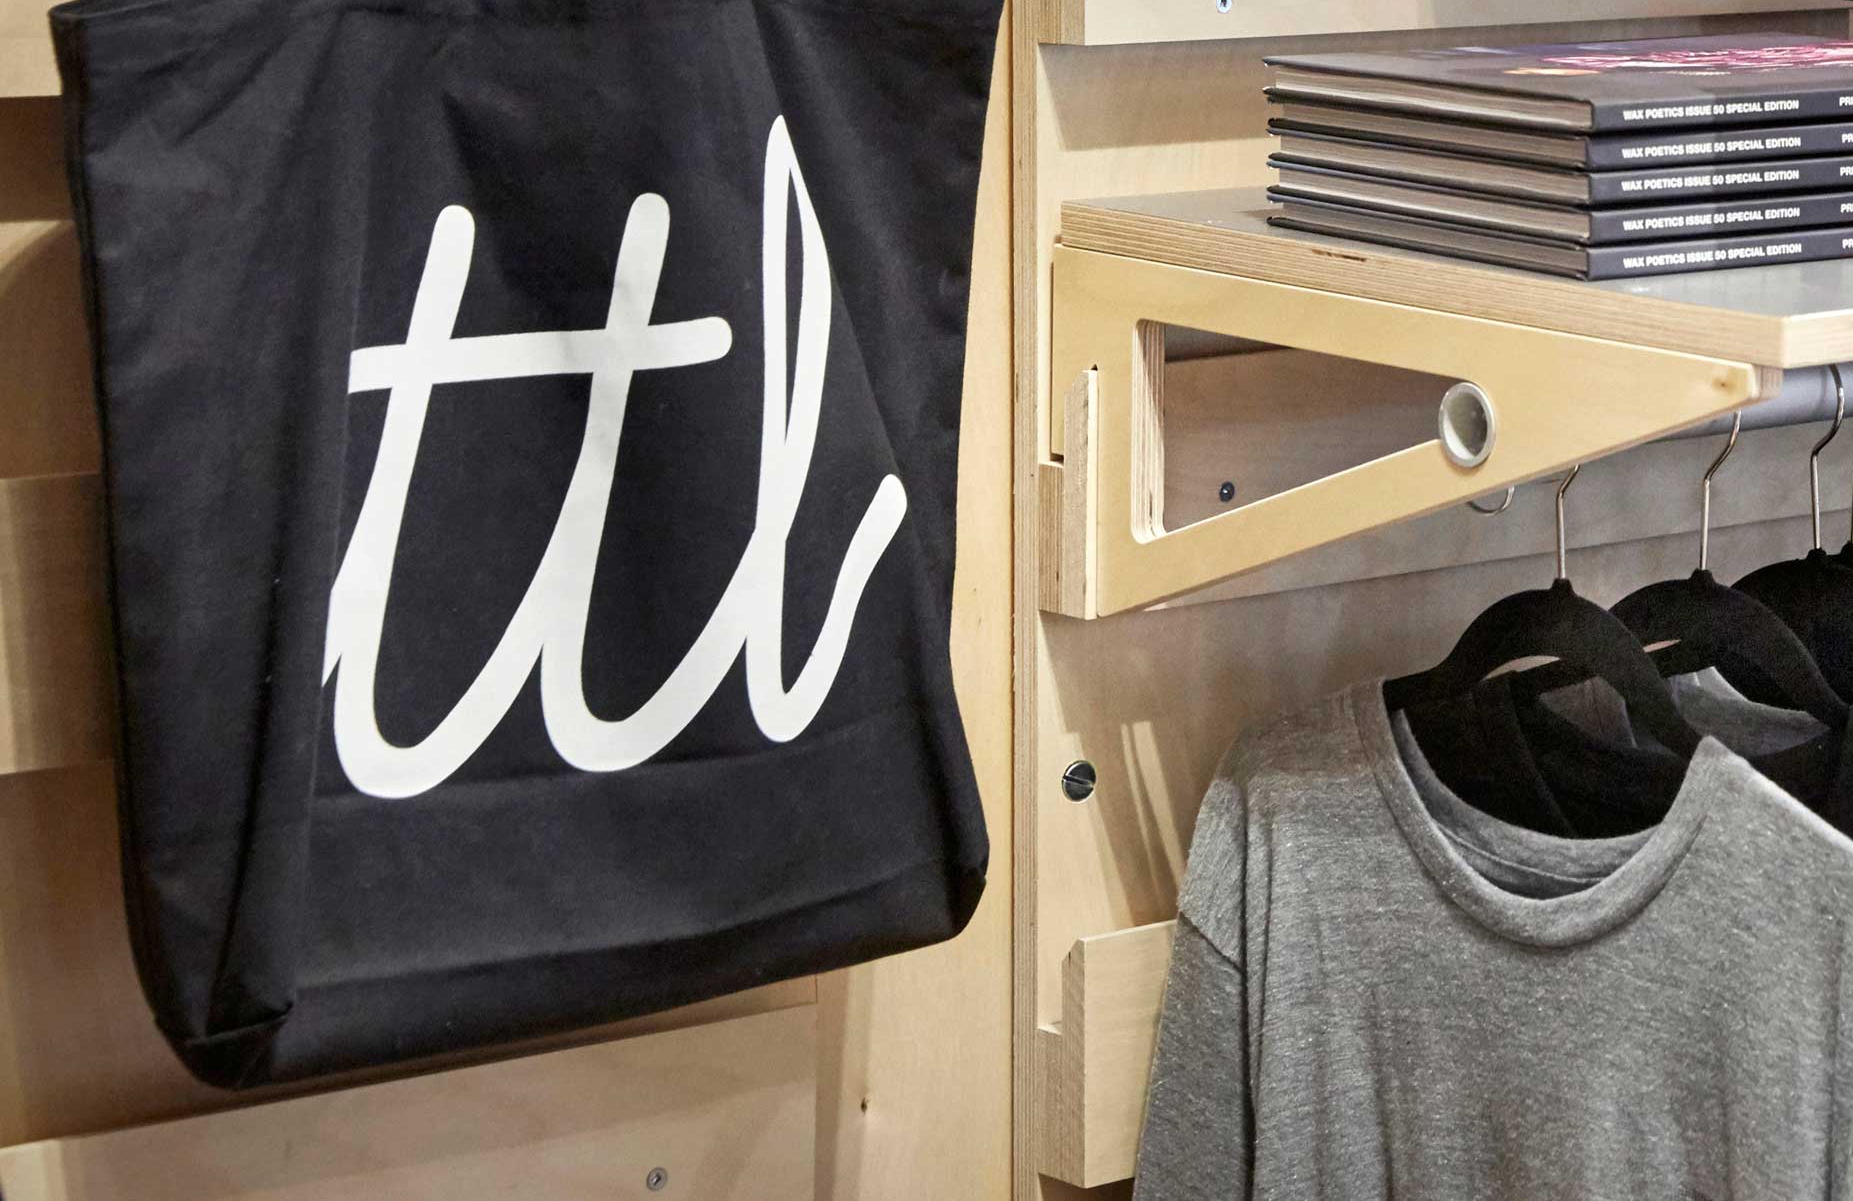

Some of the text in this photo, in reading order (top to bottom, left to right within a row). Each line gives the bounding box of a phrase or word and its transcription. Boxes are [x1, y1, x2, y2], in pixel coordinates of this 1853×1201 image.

[1623, 100, 1799, 120] WAX POETICS ISSUE 50 SPECIAL EDITION
[1622, 137, 1801, 158] WAX POETICS ISSUE 50 SPECIAL EDITION
[1622, 170, 1799, 191] WAX POETICS ISSUE 50 SPECIAL EDITION
[1623, 207, 1800, 230] WAX POETICS ISSUE 50 SPECIAL EDITION
[1624, 243, 1801, 268] WAX POETICS ISSUE 50 SPECIAL EDITION
